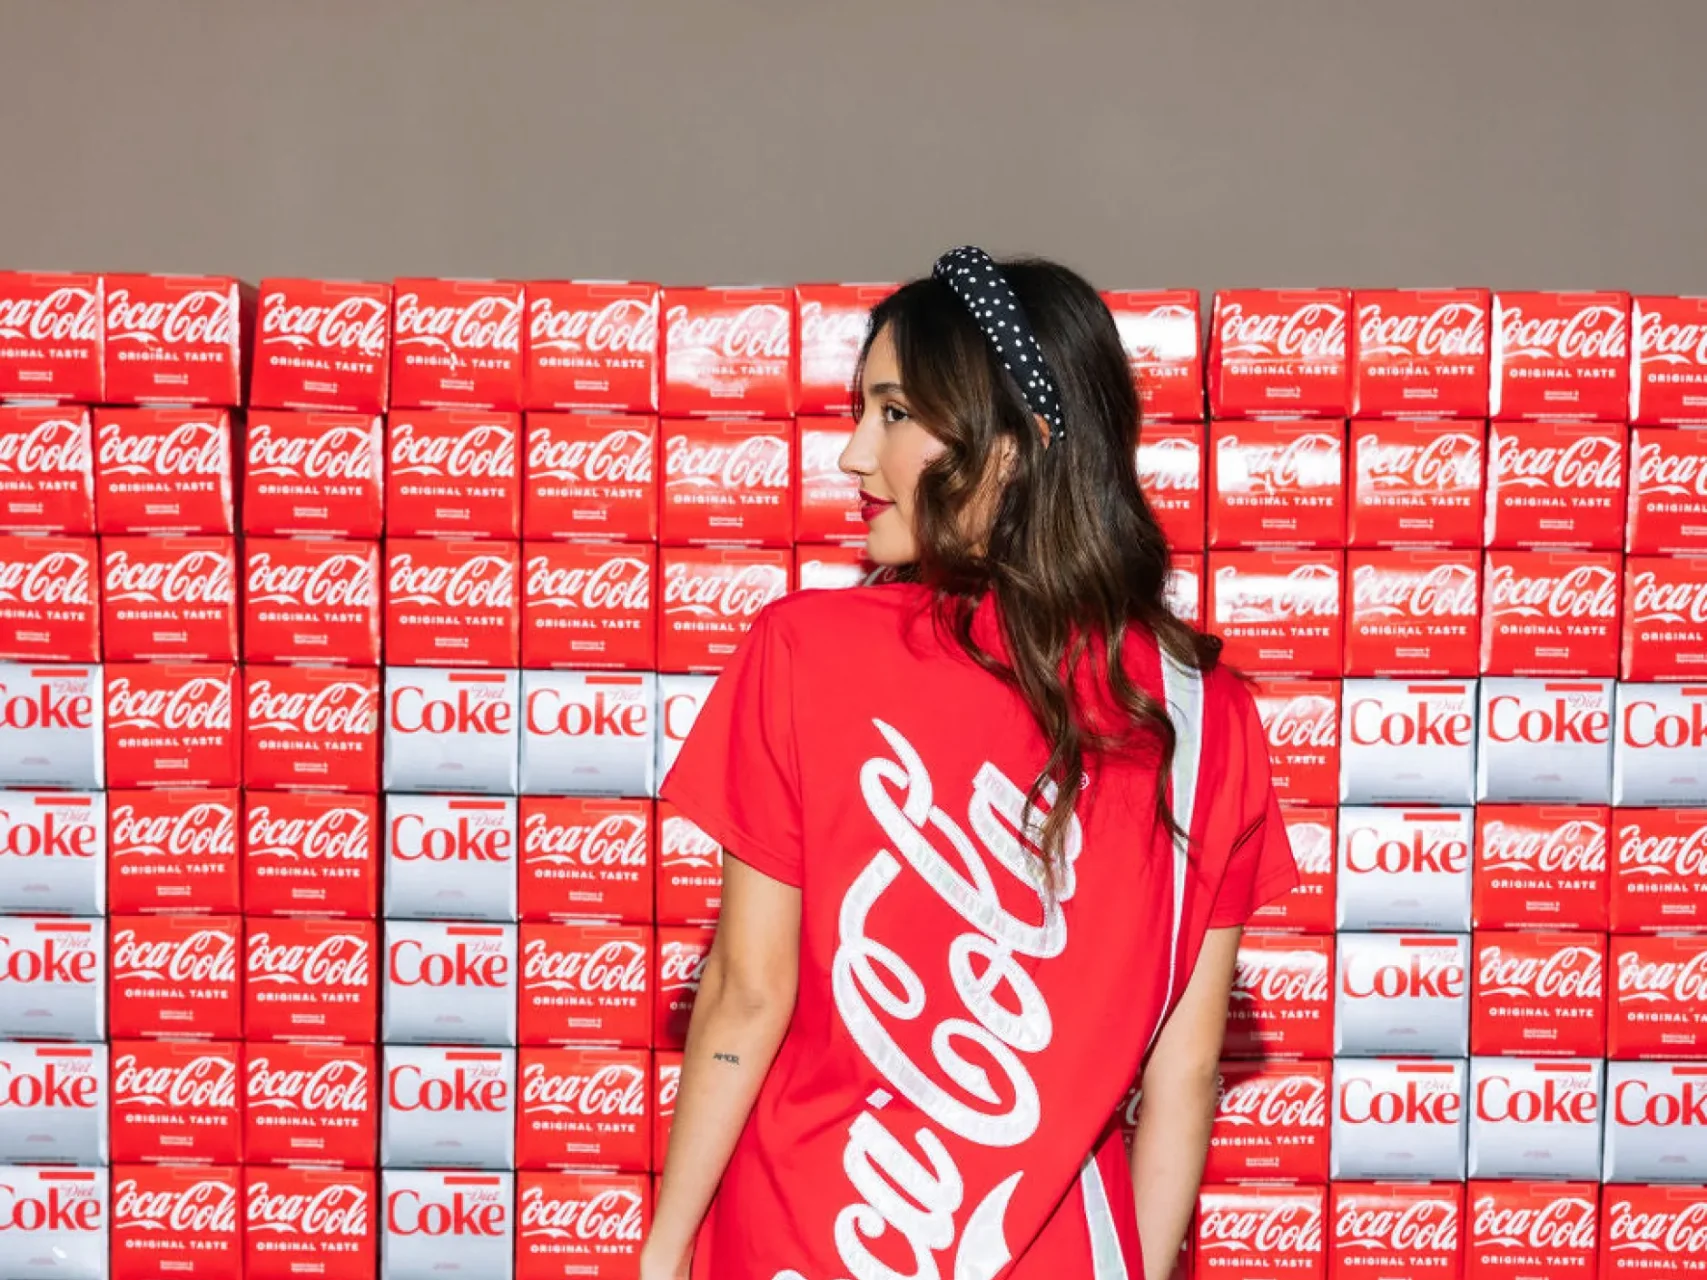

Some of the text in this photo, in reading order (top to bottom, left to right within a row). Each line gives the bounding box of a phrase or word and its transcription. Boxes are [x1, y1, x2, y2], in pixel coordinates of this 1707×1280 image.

[116, 349, 224, 363] ORIGINAL TASTE
[538, 356, 645, 370] ORIGINAL TASTE
[1367, 362, 1475, 377] ORIGINAL TASTE
[1508, 367, 1617, 379] ORIGINAL TASTE
[108, 480, 215, 494] ORIGINAL TASTE
[257, 483, 364, 497] ORIGINAL TASTE
[399, 485, 506, 498] ORIGINAL TASTE
[1504, 496, 1612, 508] ORIGINAL TASTE
[398, 614, 505, 627] ORIGINAL TASTE
[534, 617, 641, 630] ORIGINAL TASTE
[1499, 624, 1607, 637] ORIGINAL TASTE
[0, 682, 93, 729] oke
[390, 687, 511, 735] Coke
[526, 690, 647, 737] Coke
[1487, 696, 1610, 745] Coke
[1350, 701, 1472, 747] Coke
[1623, 702, 1707, 749] Cok
[0, 810, 97, 858] oke
[390, 815, 511, 863] Coke
[1345, 831, 1468, 875] Coke
[533, 867, 639, 882] ORIGINAL TASTE
[1490, 878, 1597, 891] ORIGINAL TASTE
[0, 936, 97, 984] oke
[388, 939, 509, 988] Coke
[1342, 952, 1464, 999] Coke
[123, 987, 229, 1000] ORIGINAL TASTE
[532, 995, 638, 1008] ORIGINAL TASTE
[1488, 1006, 1595, 1019] ORIGINAL TASTE
[388, 1065, 508, 1113] Coke
[1339, 1081, 1461, 1125] Coke
[1476, 1078, 1598, 1124] Coke
[1614, 1080, 1707, 1127] Cok
[255, 1115, 360, 1128] ORIGINAL TASTE
[386, 1189, 506, 1237] Coke
[1207, 1257, 1313, 1269] ORIGINAL TASTE
[1479, 1254, 1586, 1267] ORIGINAL TASTE
